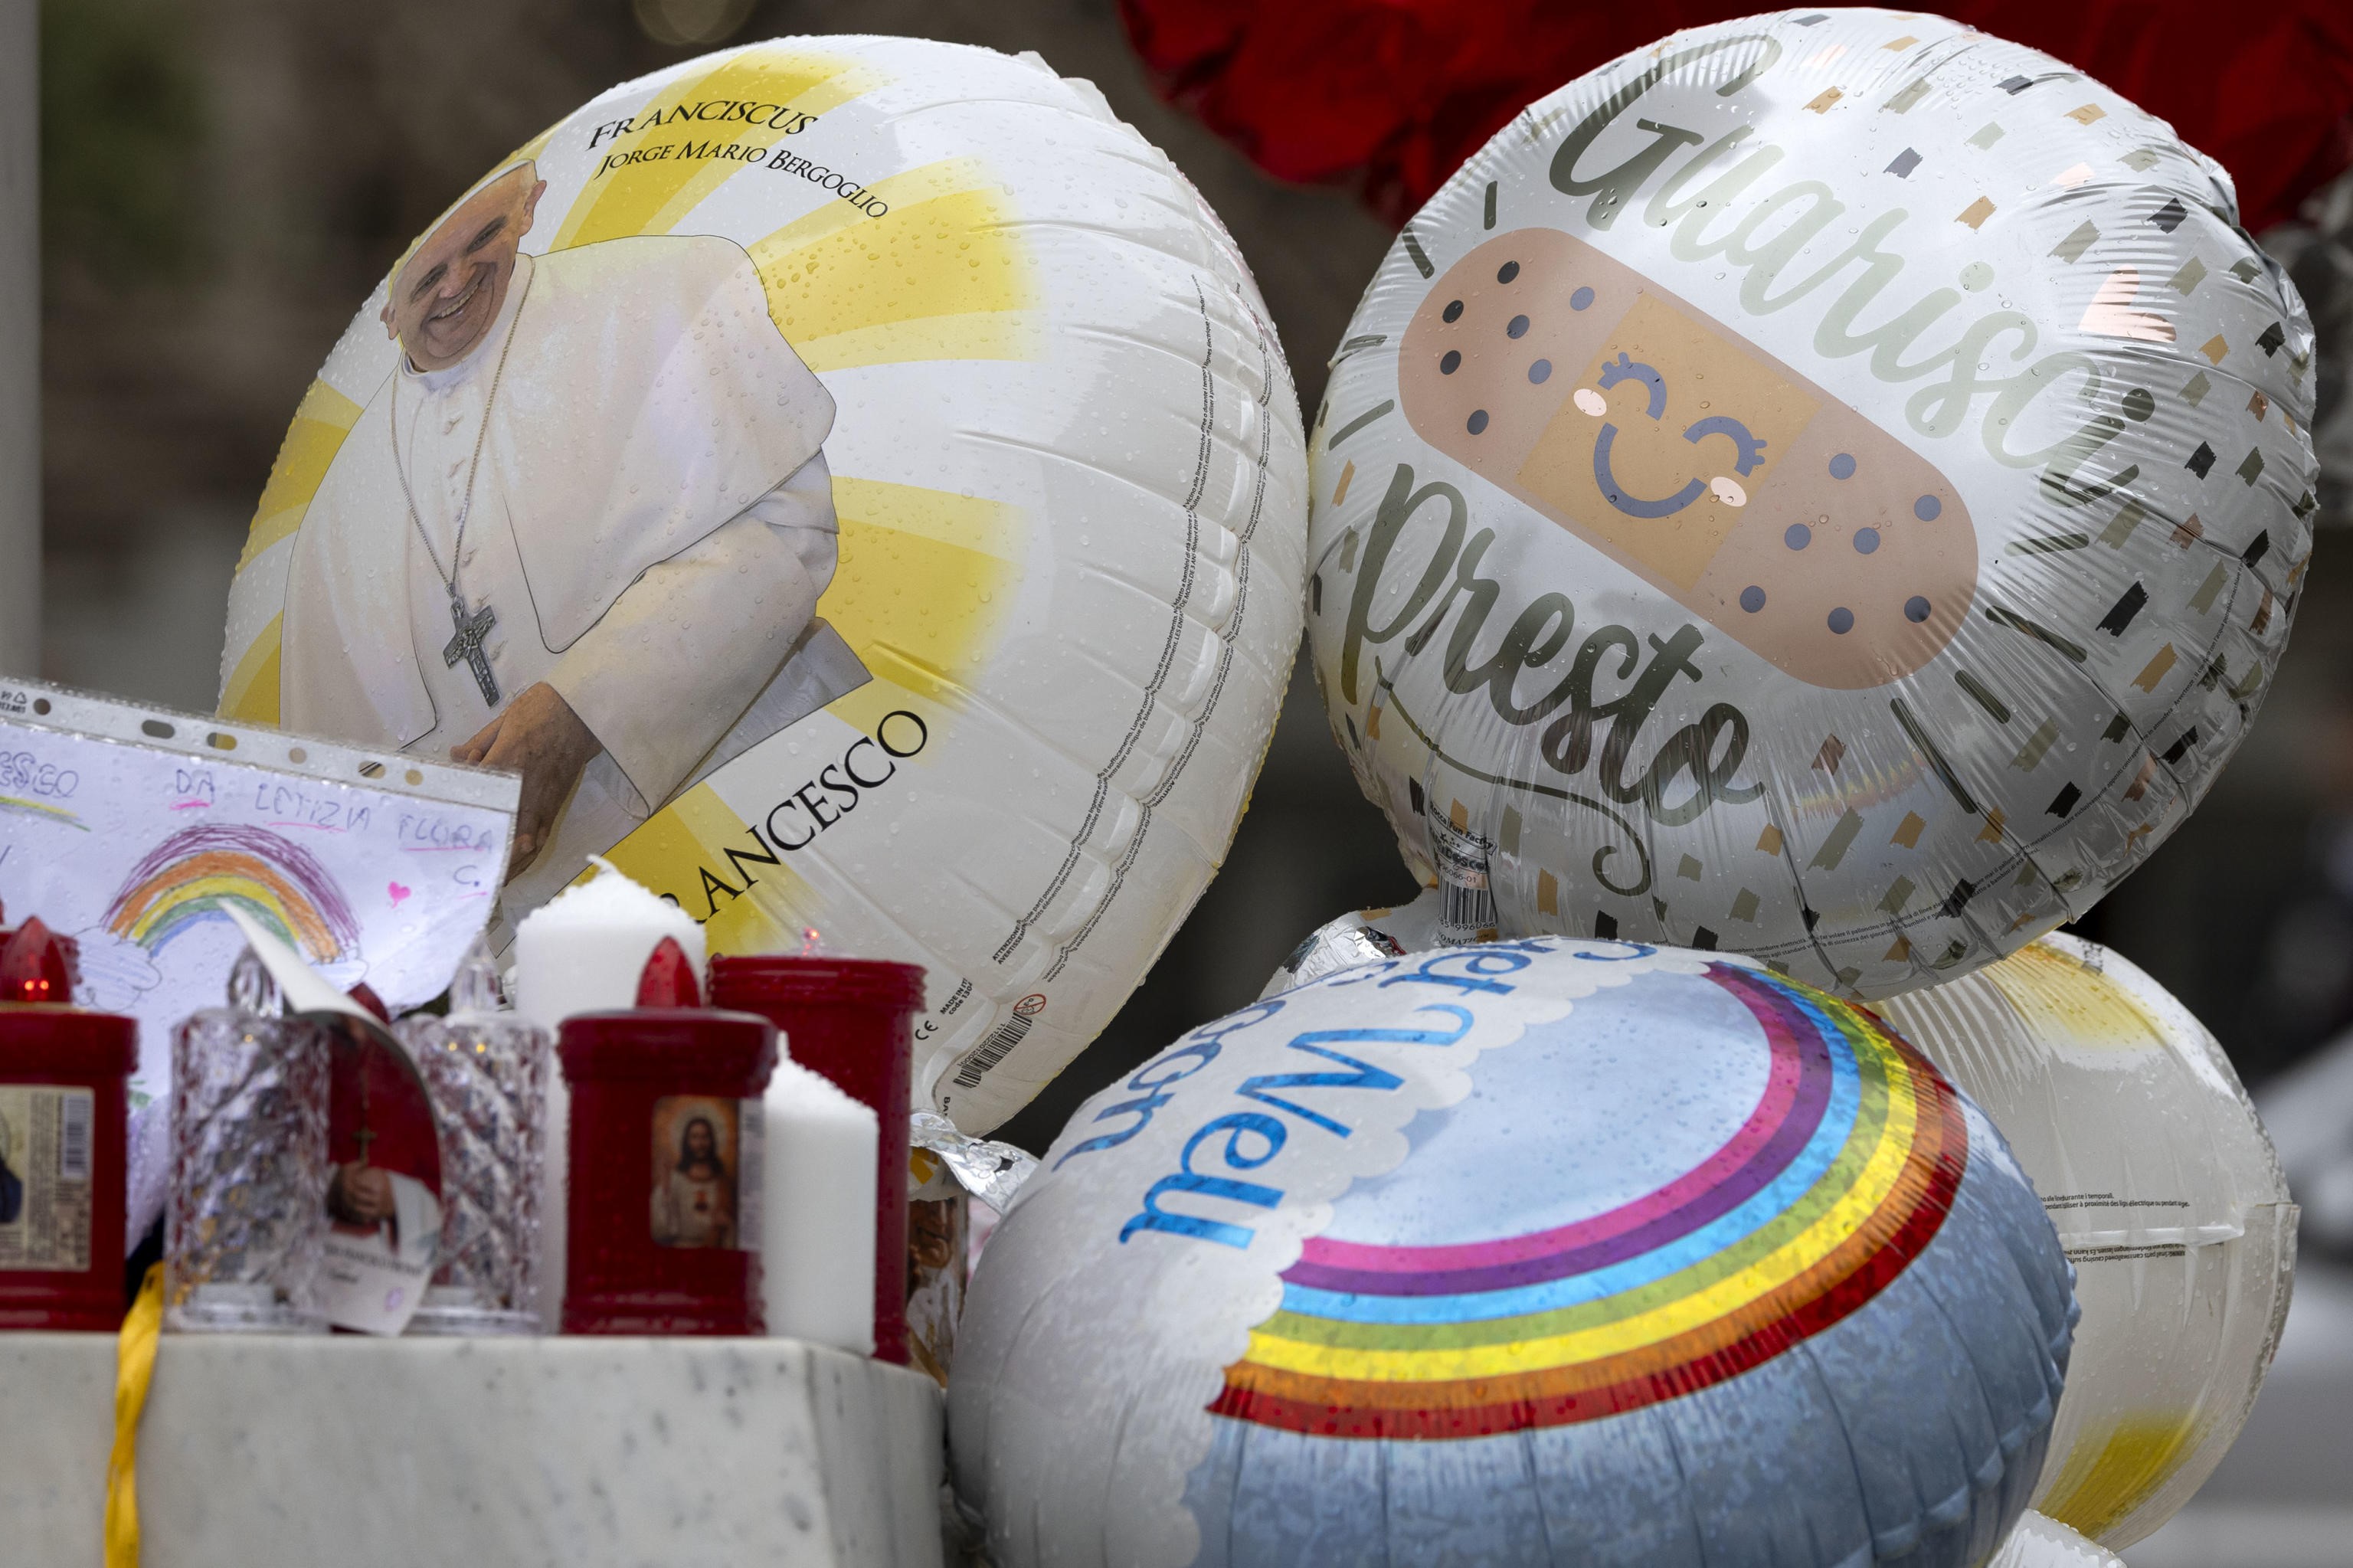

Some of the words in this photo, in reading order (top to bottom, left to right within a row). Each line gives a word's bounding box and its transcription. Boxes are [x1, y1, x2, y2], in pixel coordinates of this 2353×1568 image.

[585, 100, 820, 151] FRANCISCUS
[594, 143, 675, 179] JORGE
[674, 139, 767, 163] MARIO
[765, 149, 889, 218] BERGOGLIO
[1549, 34, 2155, 508] Guarisci
[1340, 463, 1766, 827] Presto
[659, 709, 928, 925] ANCESCO
[1119, 1003, 1474, 1249] Well
